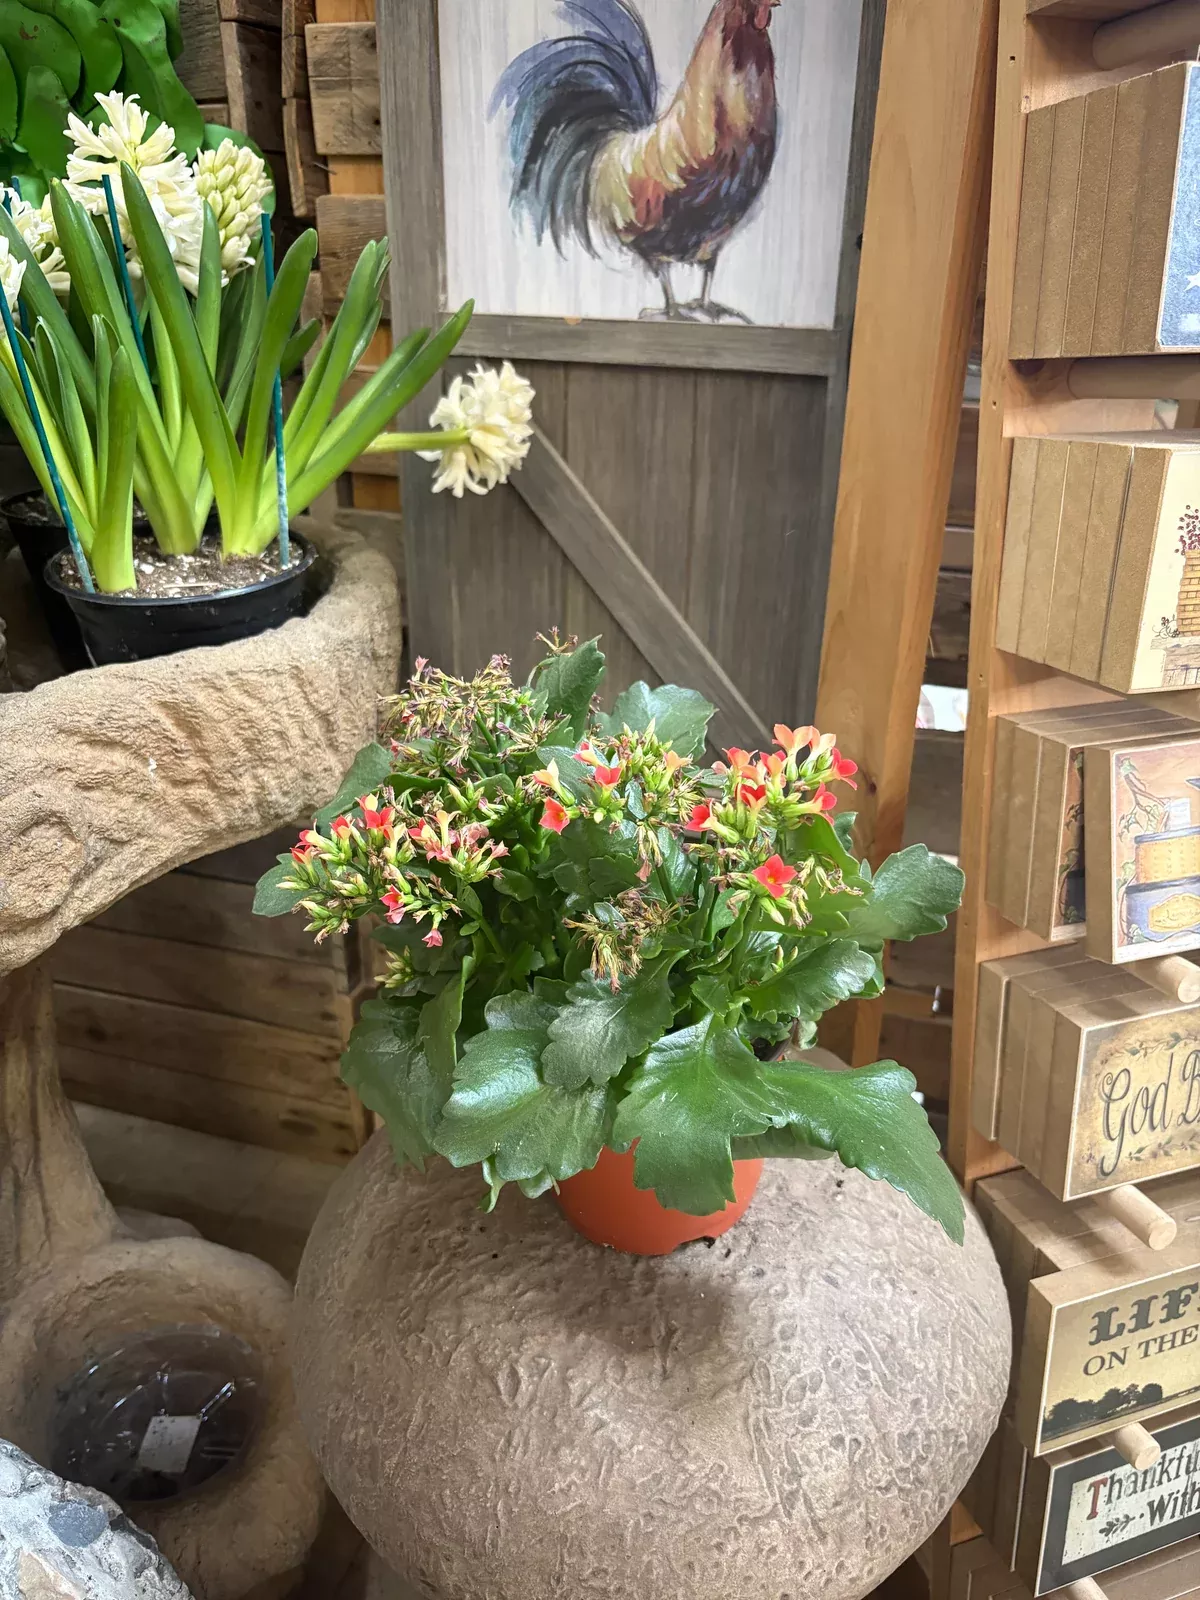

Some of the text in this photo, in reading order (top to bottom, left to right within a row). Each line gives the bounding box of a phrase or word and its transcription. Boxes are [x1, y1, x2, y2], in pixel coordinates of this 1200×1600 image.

[1099, 1052, 1173, 1177] God
[1088, 1282, 1200, 1346] LIF
[1083, 1324, 1199, 1376] ON THE
[1087, 1445, 1200, 1520] Thankfu
[1147, 1480, 1200, 1527] With
